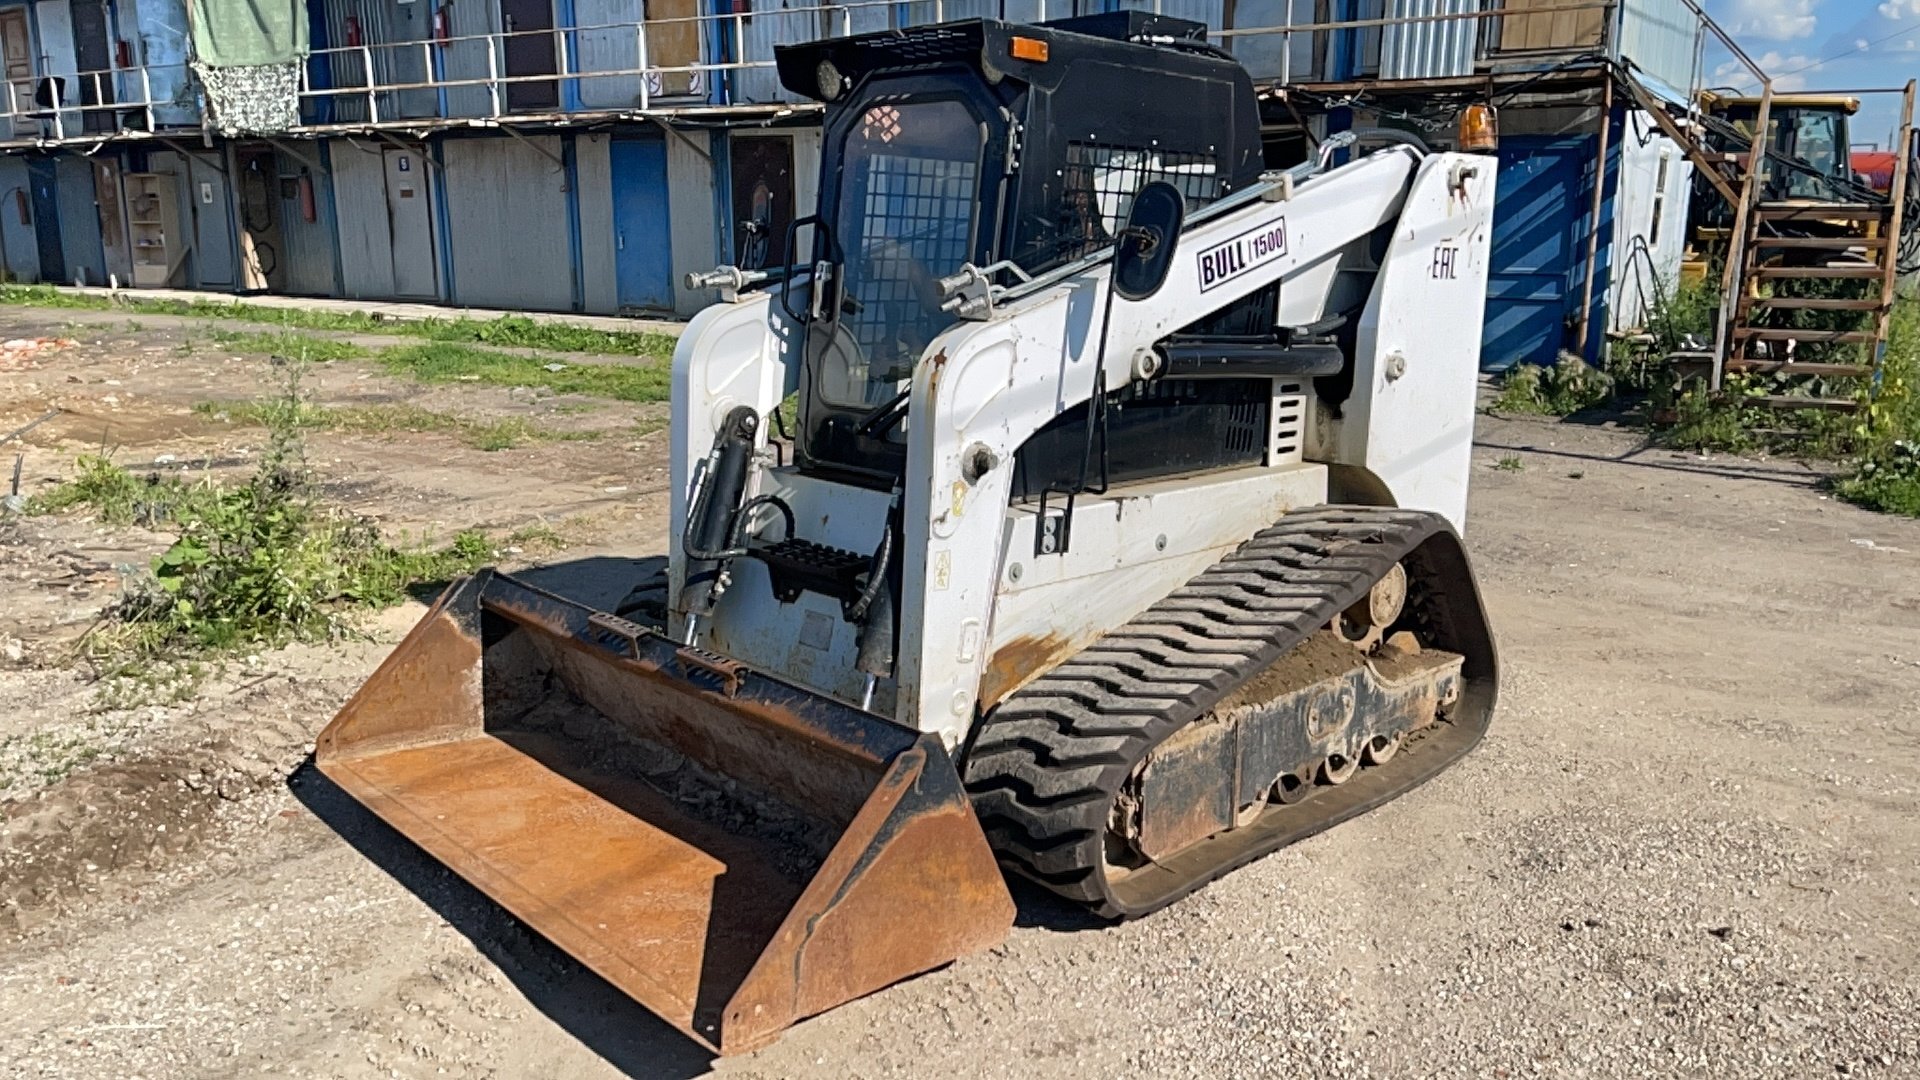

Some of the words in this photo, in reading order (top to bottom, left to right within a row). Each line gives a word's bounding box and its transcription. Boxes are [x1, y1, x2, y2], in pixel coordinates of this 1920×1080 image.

[1202, 240, 1246, 285] BULL
[1253, 228, 1283, 259] 1500
[1432, 247, 1459, 279] EAC
